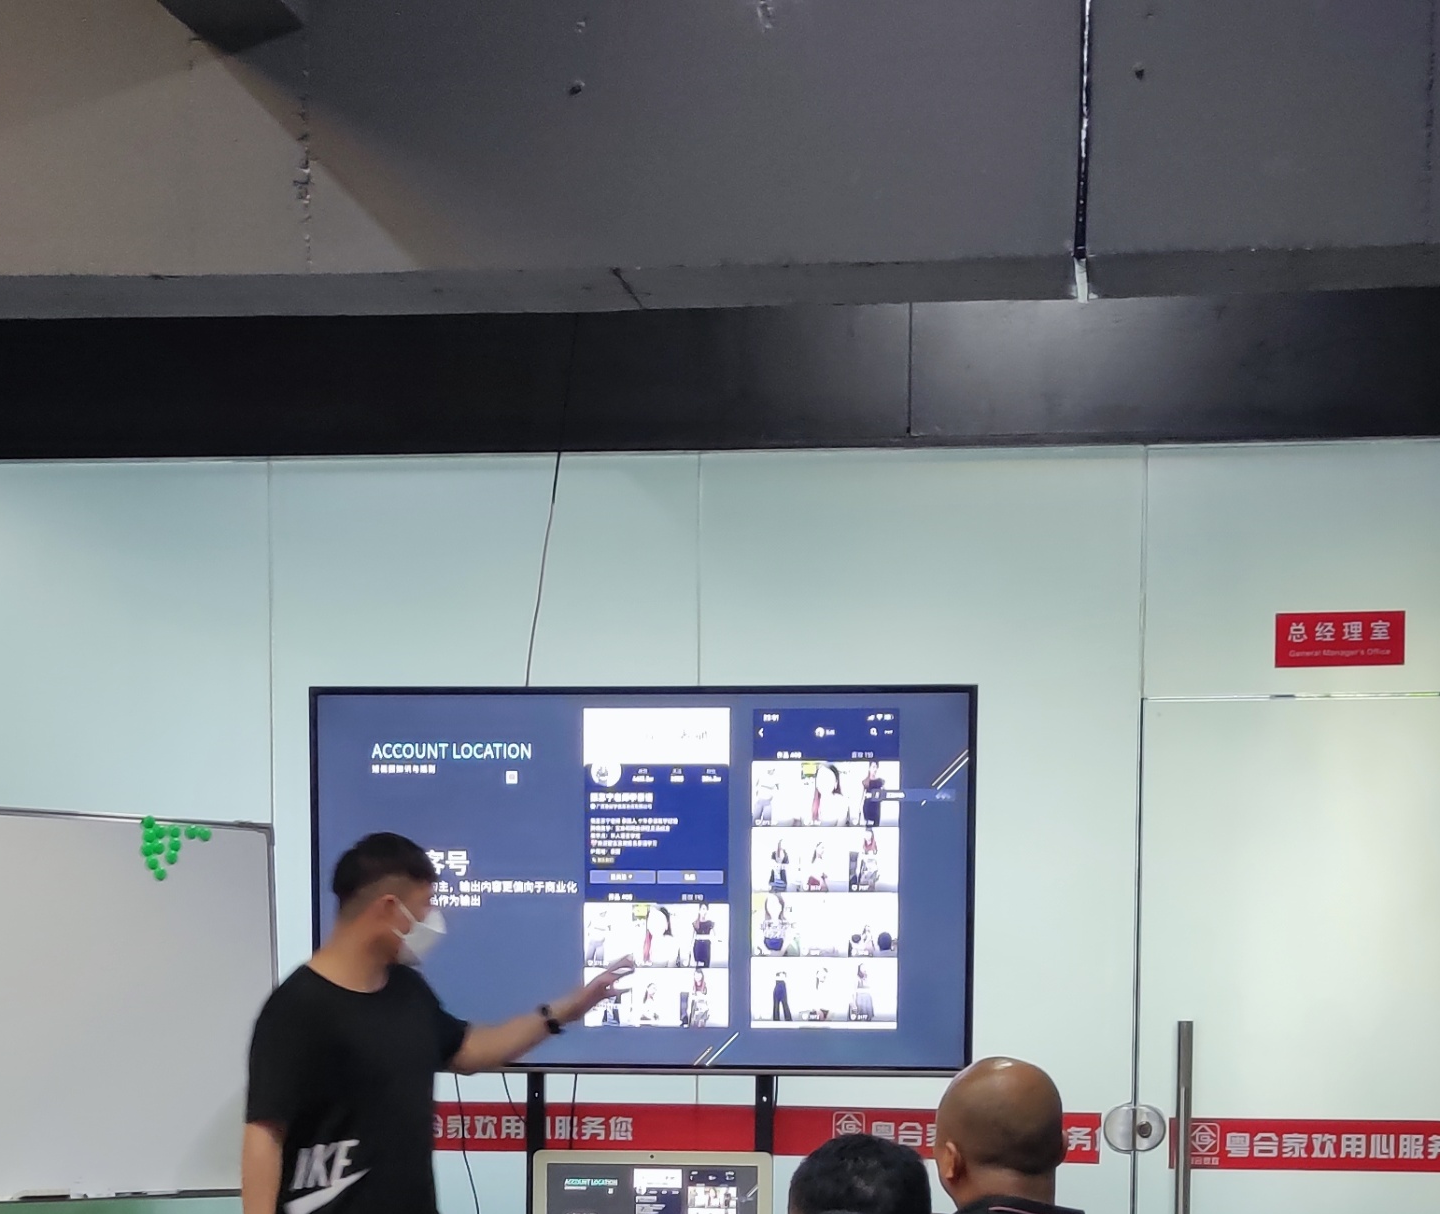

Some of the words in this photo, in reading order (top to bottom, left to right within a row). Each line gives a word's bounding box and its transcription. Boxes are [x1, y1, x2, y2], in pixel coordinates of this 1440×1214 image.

[1287, 620, 1391, 642] 总经理室
[371, 743, 449, 760] ACCOUNT
[452, 743, 532, 760] LOCATION
[433, 1115, 634, 1140] 家欢用服务您
[1067, 1125, 1101, 1152] 务
